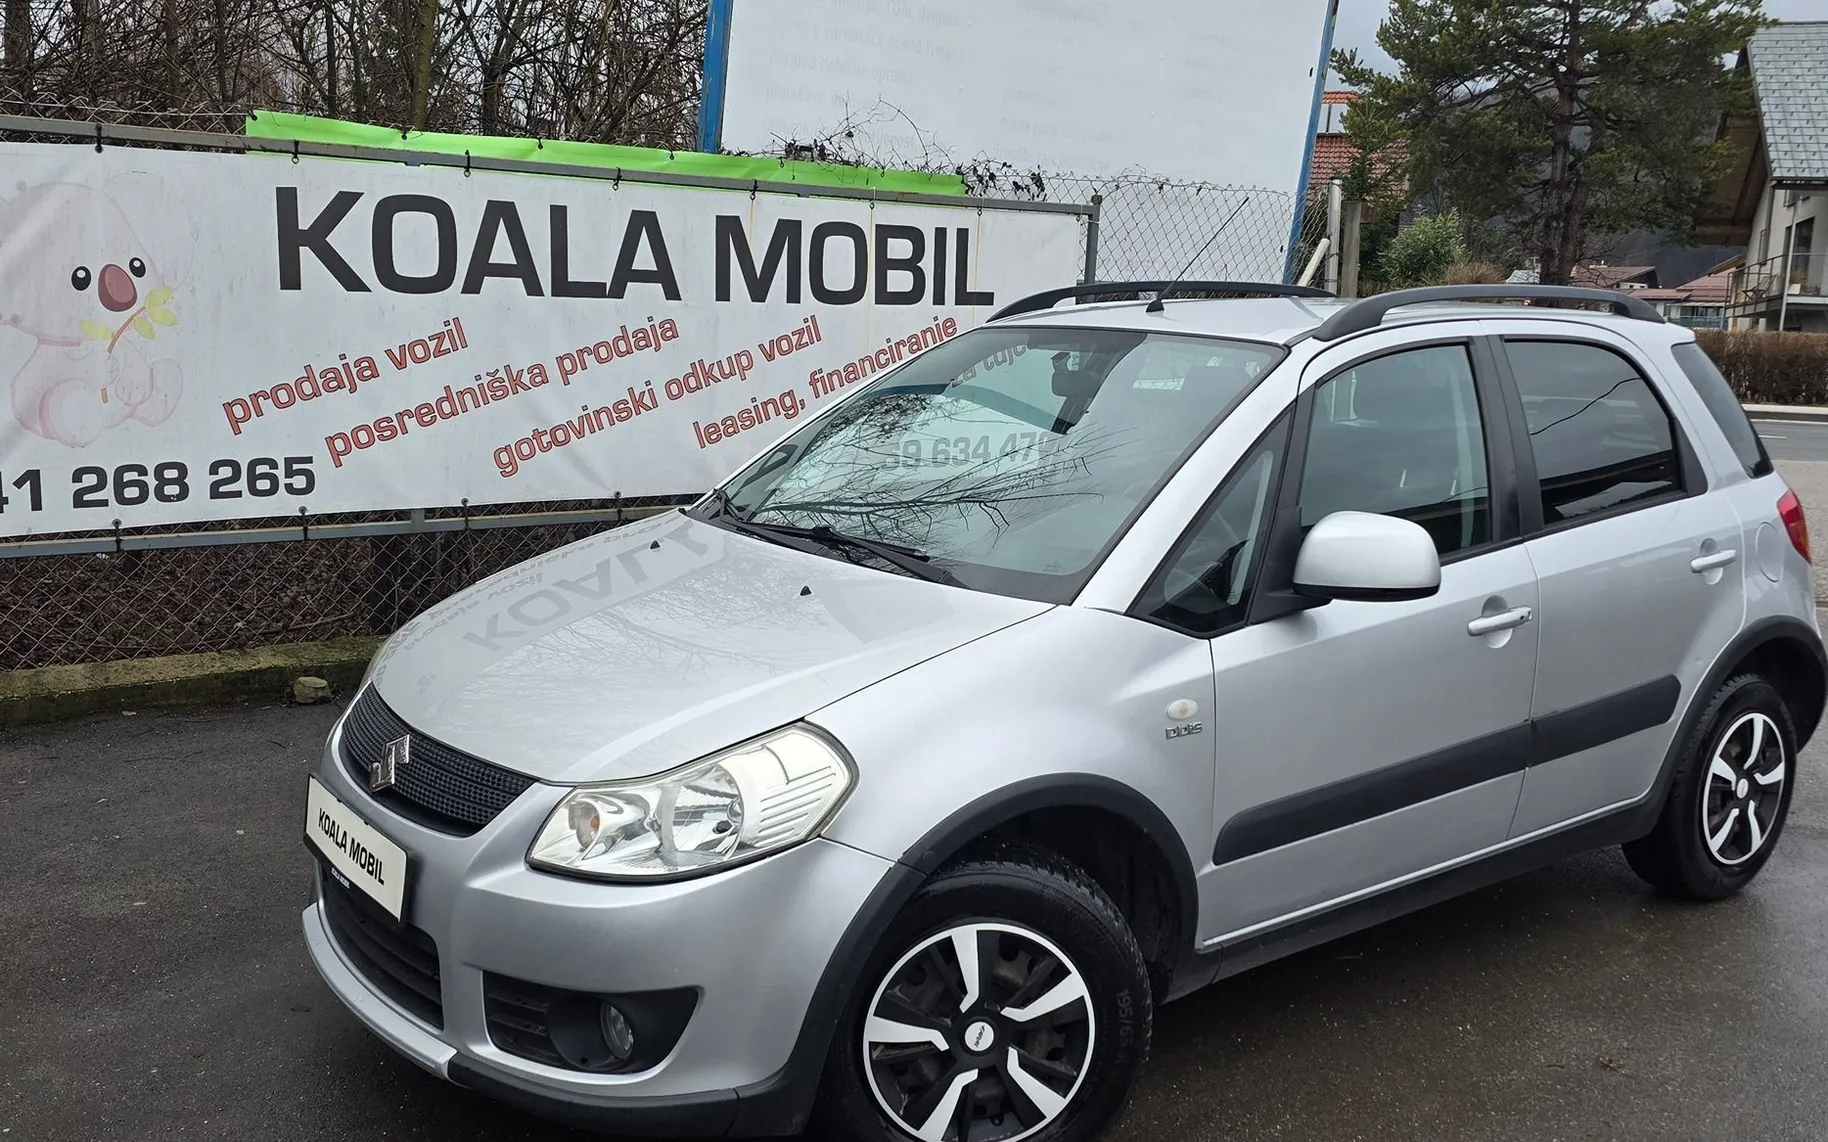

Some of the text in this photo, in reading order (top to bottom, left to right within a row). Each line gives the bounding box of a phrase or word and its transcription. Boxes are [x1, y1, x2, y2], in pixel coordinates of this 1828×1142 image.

[275, 186, 995, 306] KOALA MOBIL
[222, 317, 469, 435] prodaja vozil
[325, 315, 680, 468] posredniška prodaja
[493, 315, 822, 478] gotovinski odkup vozil
[693, 386, 806, 449] leasing,
[72, 462, 190, 509] 268
[208, 455, 316, 500] 265
[318, 807, 348, 854] KOALA
[348, 837, 385, 886] MOBIL
